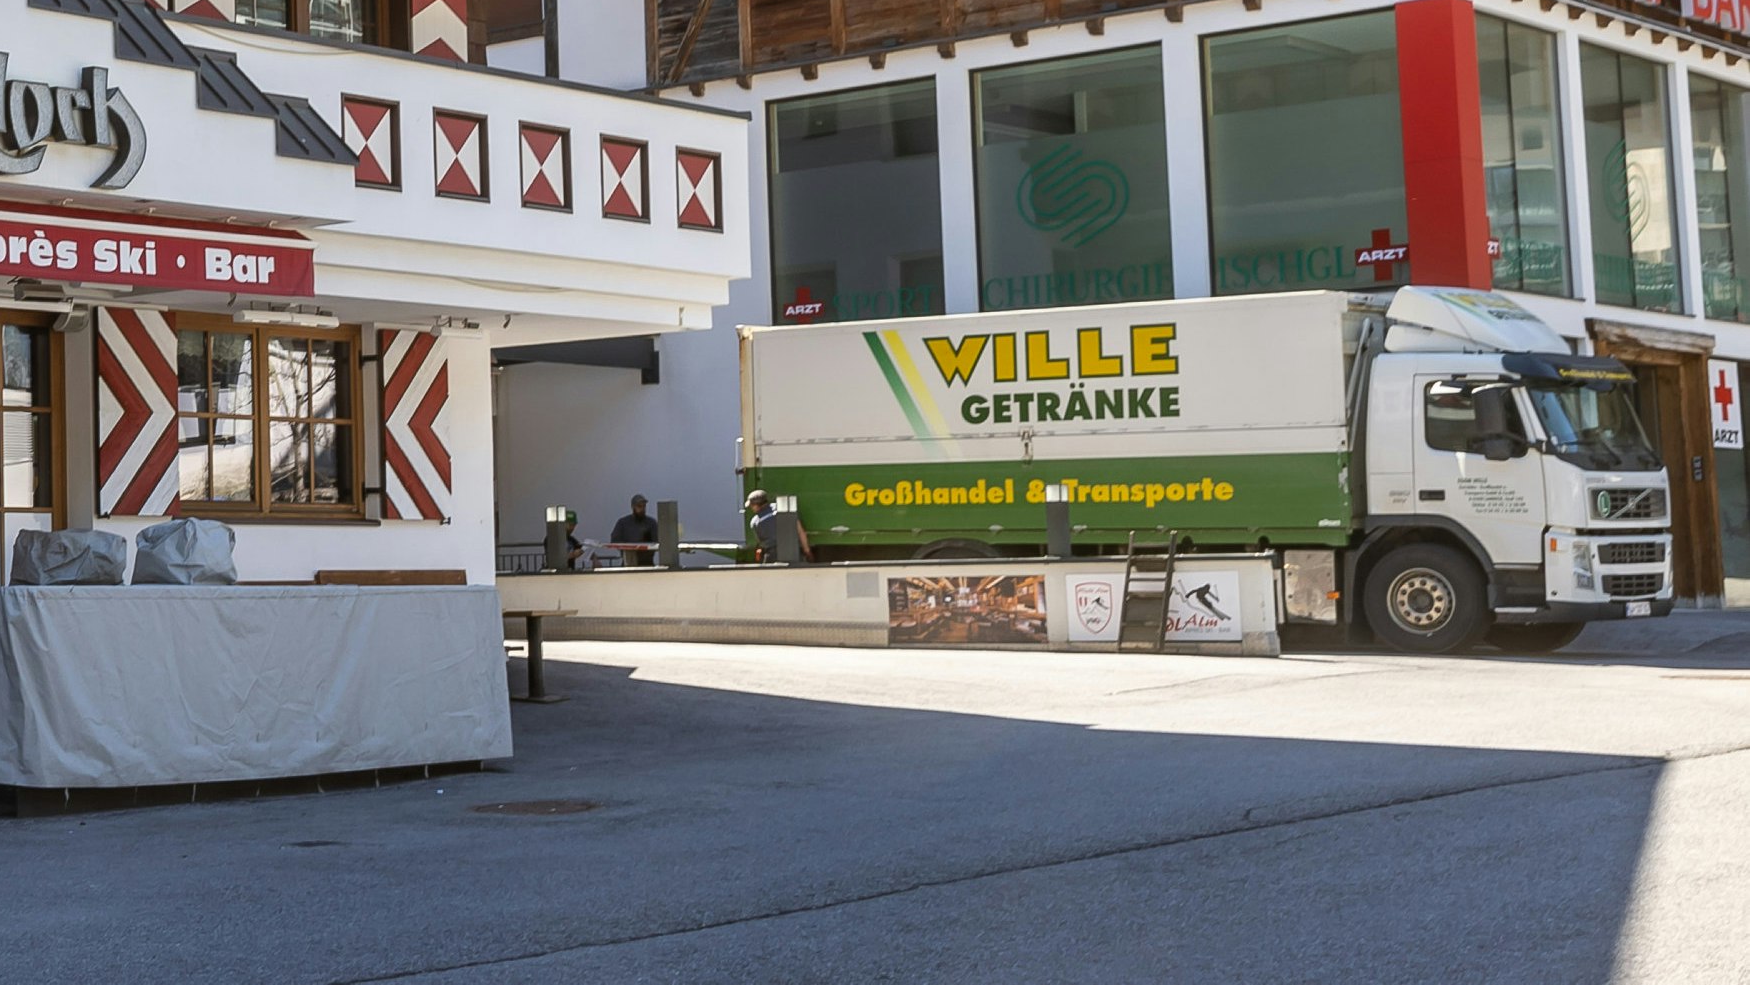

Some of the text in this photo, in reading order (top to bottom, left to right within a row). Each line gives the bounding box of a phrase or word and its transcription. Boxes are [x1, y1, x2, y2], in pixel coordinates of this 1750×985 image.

[94, 239, 157, 275] Ski
[204, 247, 275, 284] Bar
[1358, 247, 1407, 263] ARZT
[832, 244, 1356, 319] SPORT CHIRURGIE ISCHGL
[785, 303, 822, 316] ARZT
[922, 322, 1179, 388] WILLE
[961, 382, 1180, 425] GETRÄNKE
[1715, 428, 1739, 444] ARZT
[844, 477, 1234, 508] Großhandel & Transporte
